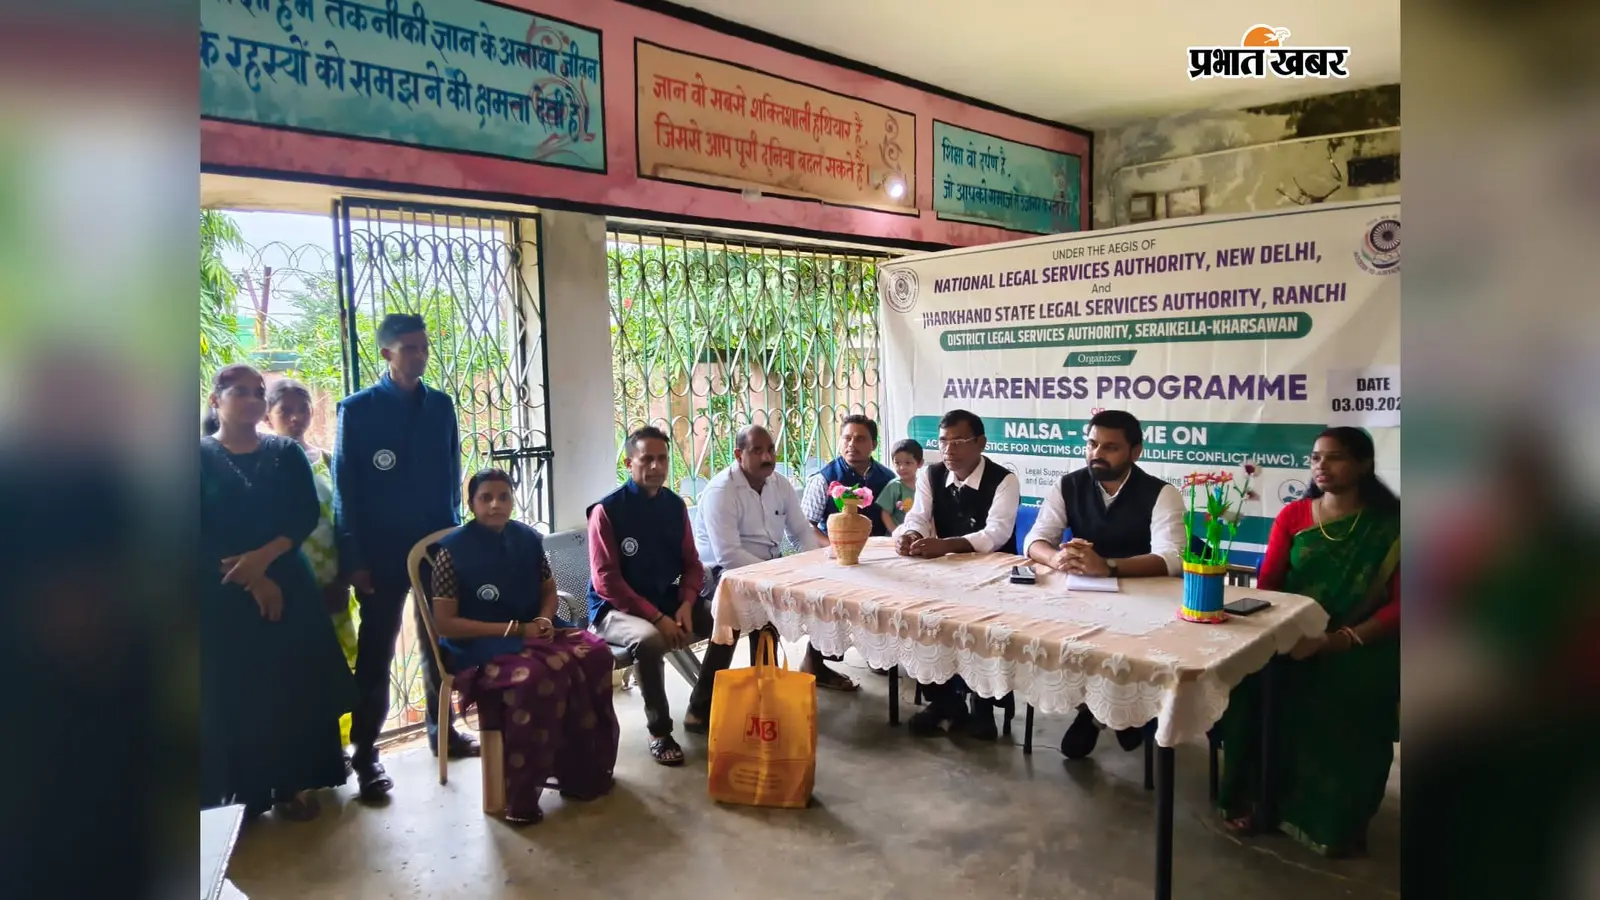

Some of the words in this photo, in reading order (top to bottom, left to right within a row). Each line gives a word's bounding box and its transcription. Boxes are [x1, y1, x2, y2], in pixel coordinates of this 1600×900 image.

[324, 0, 429, 46] तकनीकी
[431, 20, 478, 64] ज्ञान
[480, 20, 498, 61] के
[225, 34, 311, 93] रहस्यों
[315, 40, 345, 92] को
[446, 67, 472, 113] की
[653, 73, 688, 101] ज्ञान
[691, 72, 707, 108] वो
[710, 84, 746, 118] सबसे
[653, 111, 703, 154] जिससे
[705, 131, 732, 159] आप
[734, 129, 758, 169] पूरी
[941, 136, 964, 166] शिक्षा
[1052, 249, 1085, 261] UNDER
[1088, 246, 1106, 256] THE
[1108, 242, 1138, 254] AEGIS
[1141, 239, 1156, 250] OF
[934, 276, 995, 294] NATIONAL
[999, 269, 1038, 287] LEGAL
[1042, 261, 1110, 283] SERVICES
[1113, 252, 1211, 277] AUTHORITY,
[1216, 247, 1255, 268] NEW
[1260, 241, 1322, 264] DELHI,
[995, 304, 1035, 322] STATE
[1039, 301, 1081, 319] LEGAL
[1085, 295, 1158, 316] SERVICES
[1162, 288, 1267, 311] AUTHORITY,
[1272, 282, 1347, 305] RANCHI
[1091, 283, 1111, 294] And
[947, 332, 985, 346] DISTRICT
[987, 331, 1016, 344] LEGAL
[1017, 328, 1065, 342] SERVICES
[1067, 322, 1133, 340] AUTHORITY,
[1135, 316, 1298, 338] SERAIKELLA-KHARSAWAN
[1077, 354, 1121, 364] Organizes
[943, 376, 1088, 399] AWARENESS
[1096, 373, 1308, 400] PROGRAMME
[1356, 377, 1391, 391] DATE
[1005, 422, 1063, 440] NALSA
[1172, 426, 1207, 446] ON
[1011, 443, 1029, 453] FOR
[1031, 444, 1070, 454] VICTIMS
[1186, 451, 1248, 464] CONFLICT
